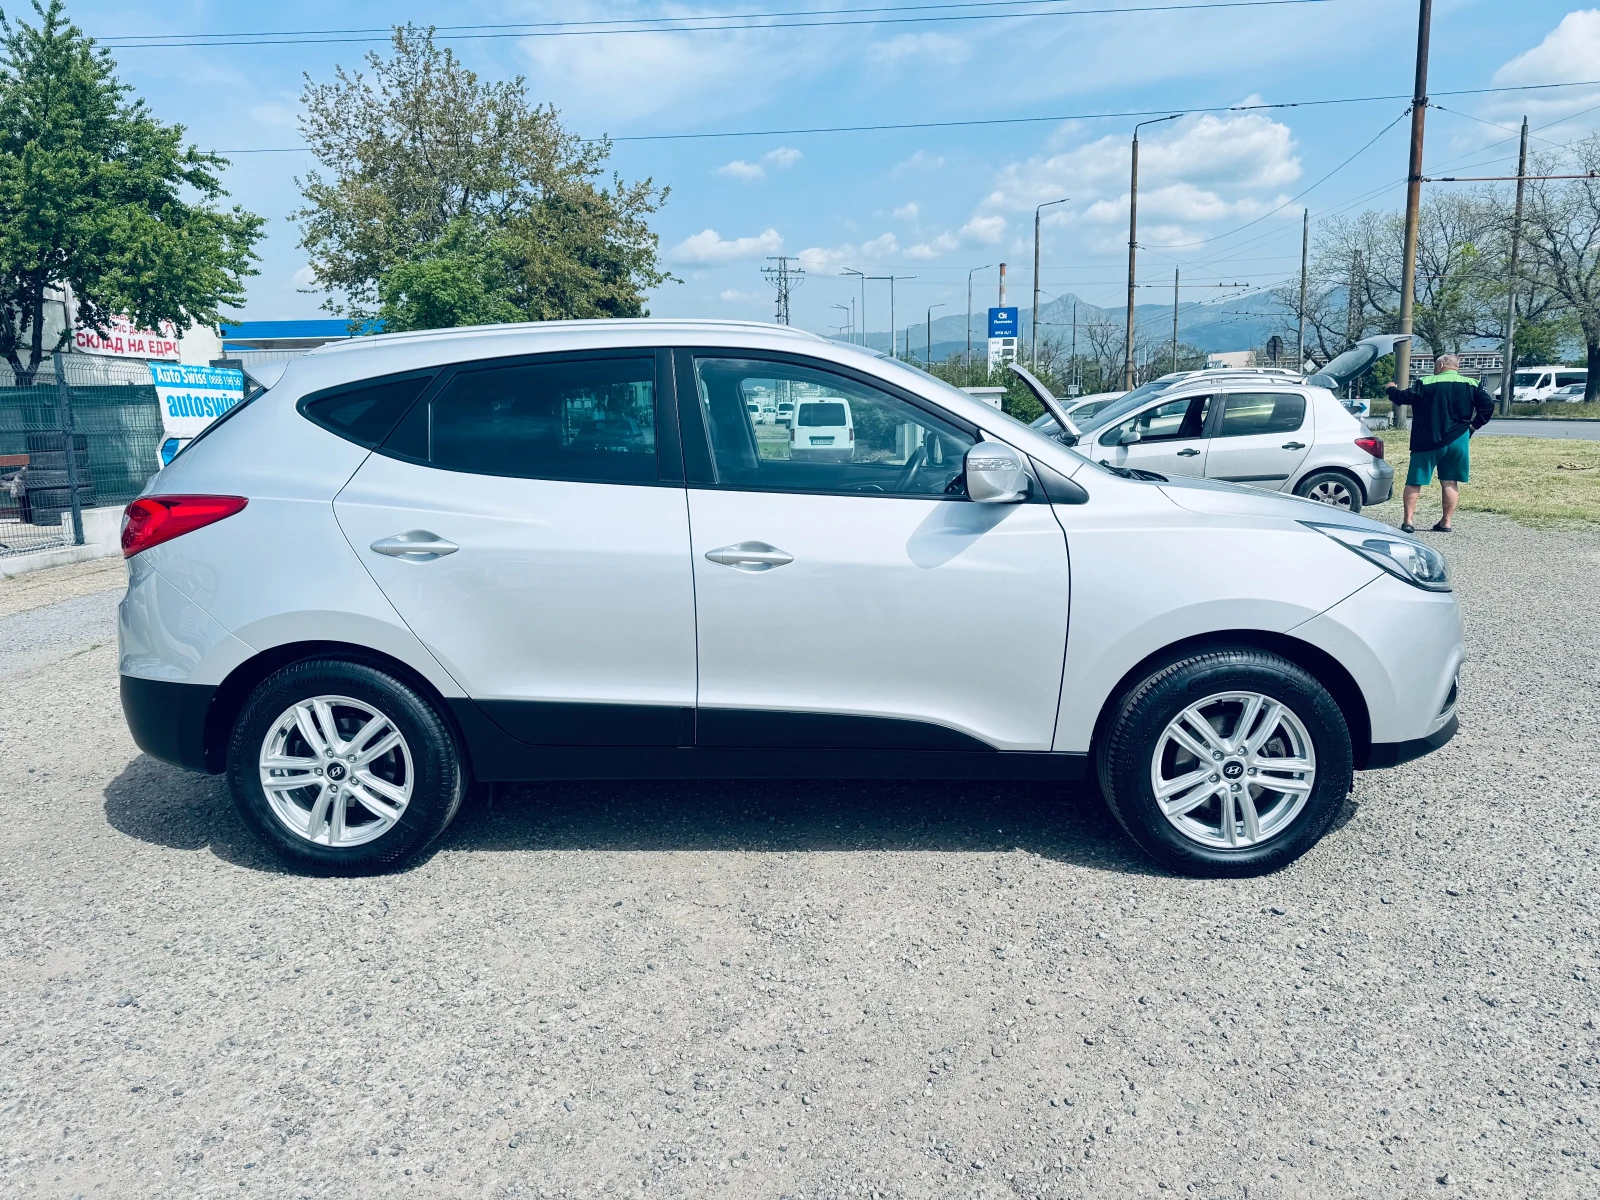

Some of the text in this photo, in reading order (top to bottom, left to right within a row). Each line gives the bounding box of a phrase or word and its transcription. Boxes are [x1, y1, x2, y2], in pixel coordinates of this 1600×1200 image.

[76, 332, 124, 354] СКЛАД
[128, 338, 145, 353] НА
[156, 366, 180, 383] Auto
[180, 368, 207, 385] Swiss
[166, 393, 242, 418] autoswi
